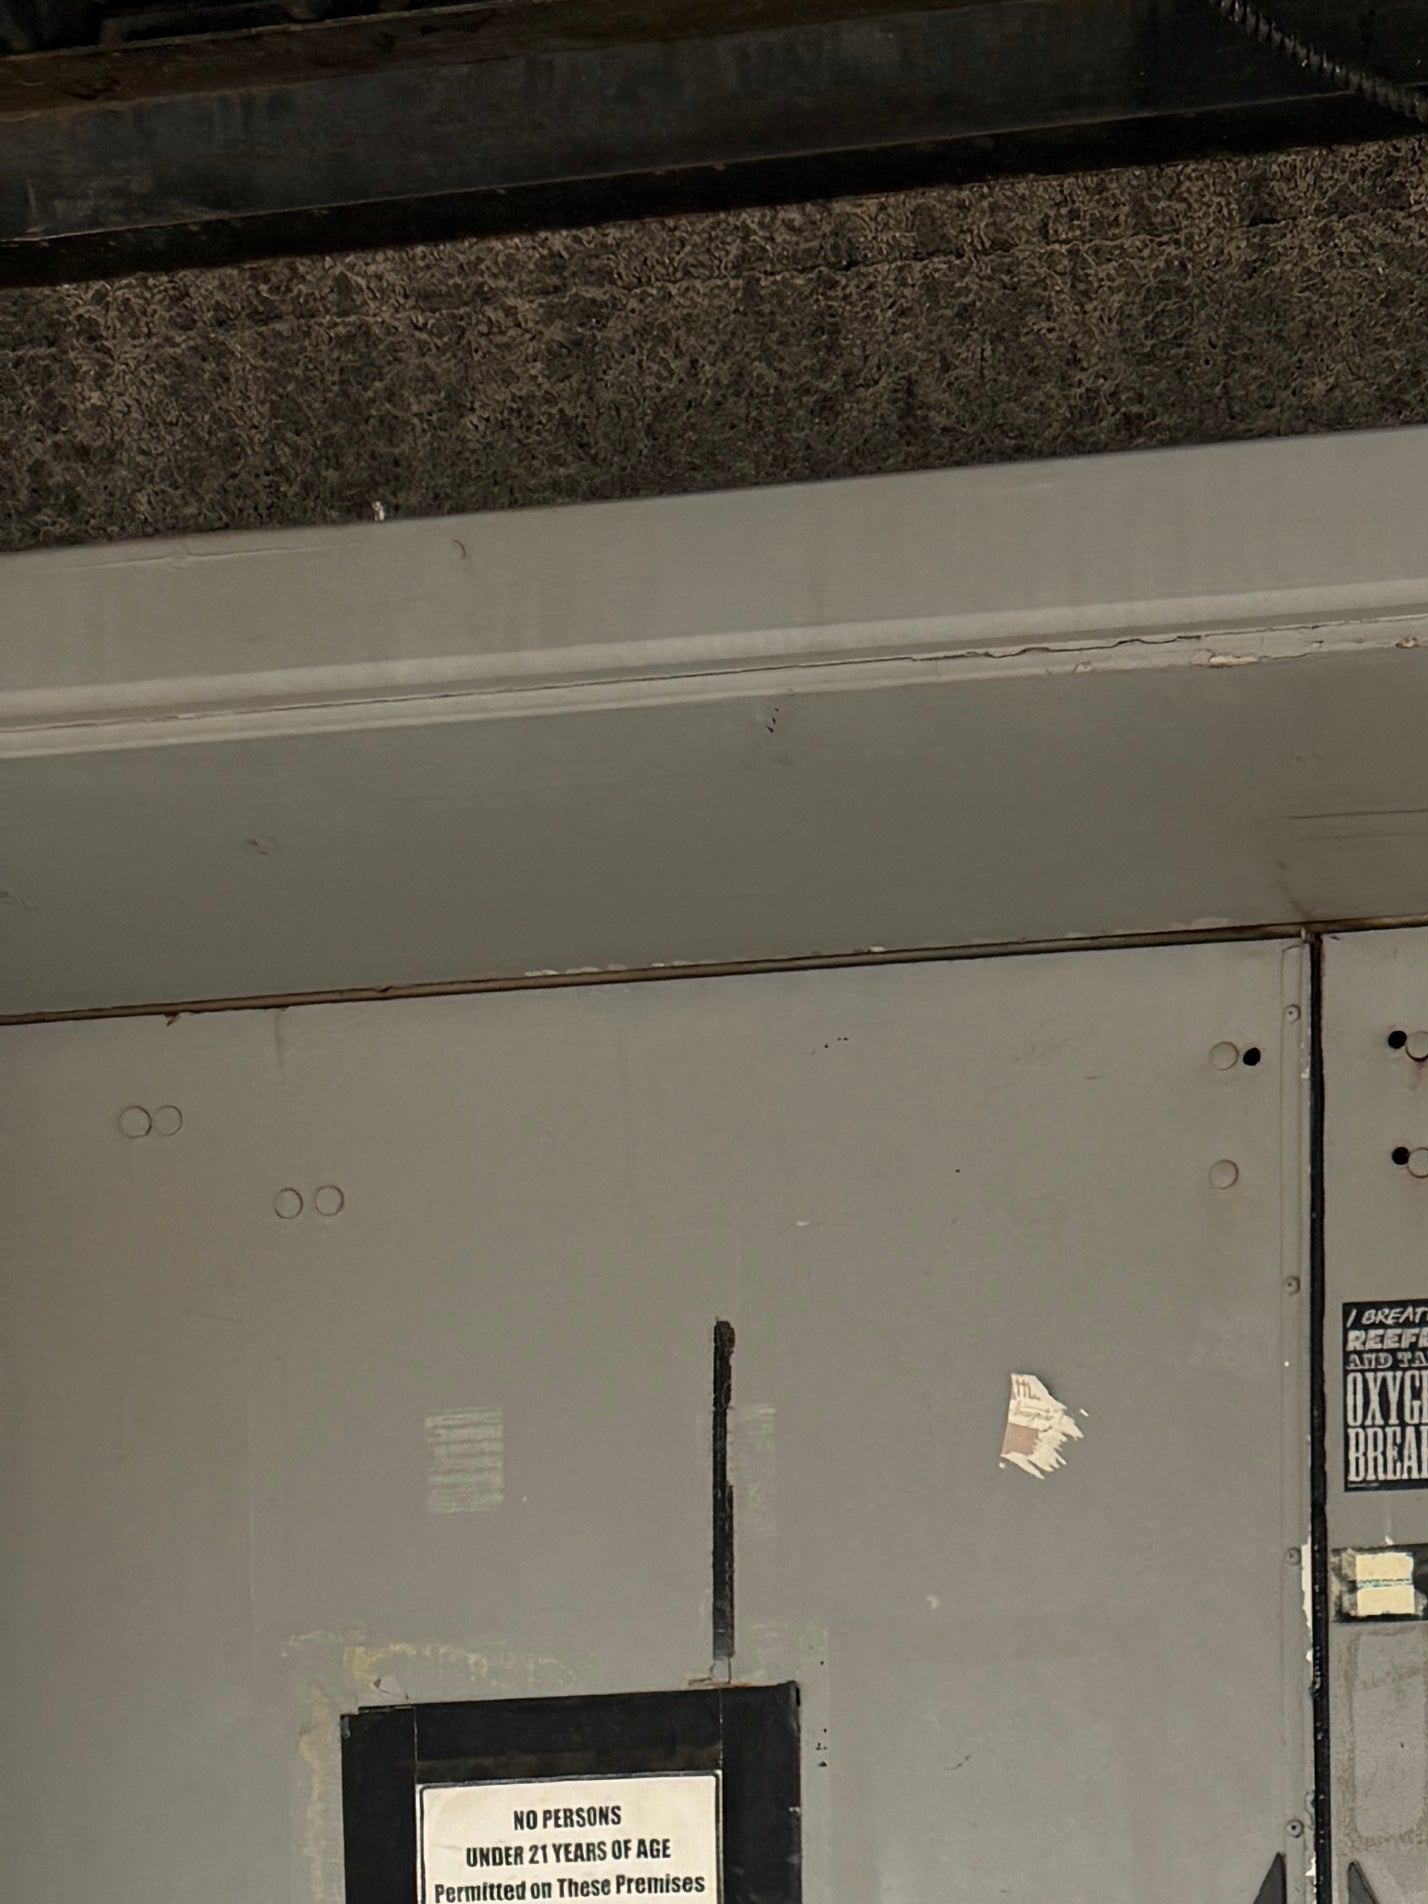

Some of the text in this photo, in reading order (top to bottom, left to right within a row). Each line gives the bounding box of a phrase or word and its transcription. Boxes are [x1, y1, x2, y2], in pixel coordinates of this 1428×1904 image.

[1346, 1309, 1357, 1328] I
[1346, 1353, 1393, 1370] AND
[514, 1805, 622, 1831] NO PERSONS
[466, 1838, 671, 1868] UNDER 21 YEARS OF AGE
[435, 1874, 706, 1904] Permitted on These Premises
